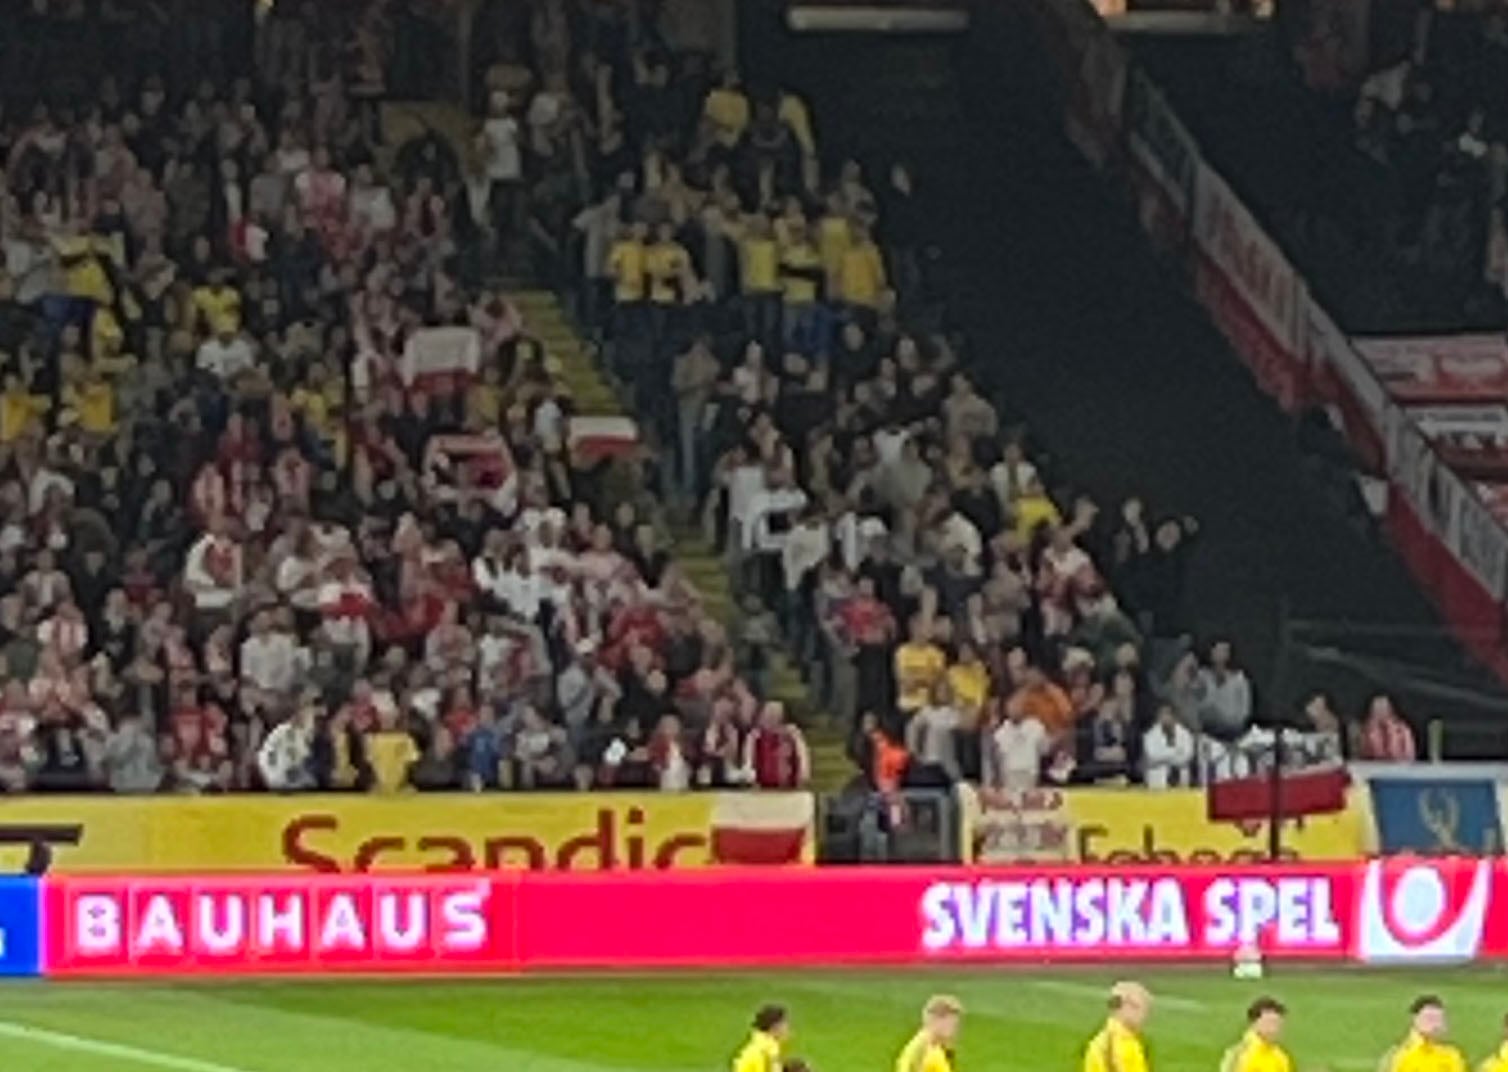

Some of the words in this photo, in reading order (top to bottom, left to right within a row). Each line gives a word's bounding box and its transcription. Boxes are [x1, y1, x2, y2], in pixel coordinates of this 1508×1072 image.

[76, 893, 488, 951] BAUHAUS
[921, 878, 1190, 949] SVENSKA
[1204, 875, 1341, 944] SPEL
